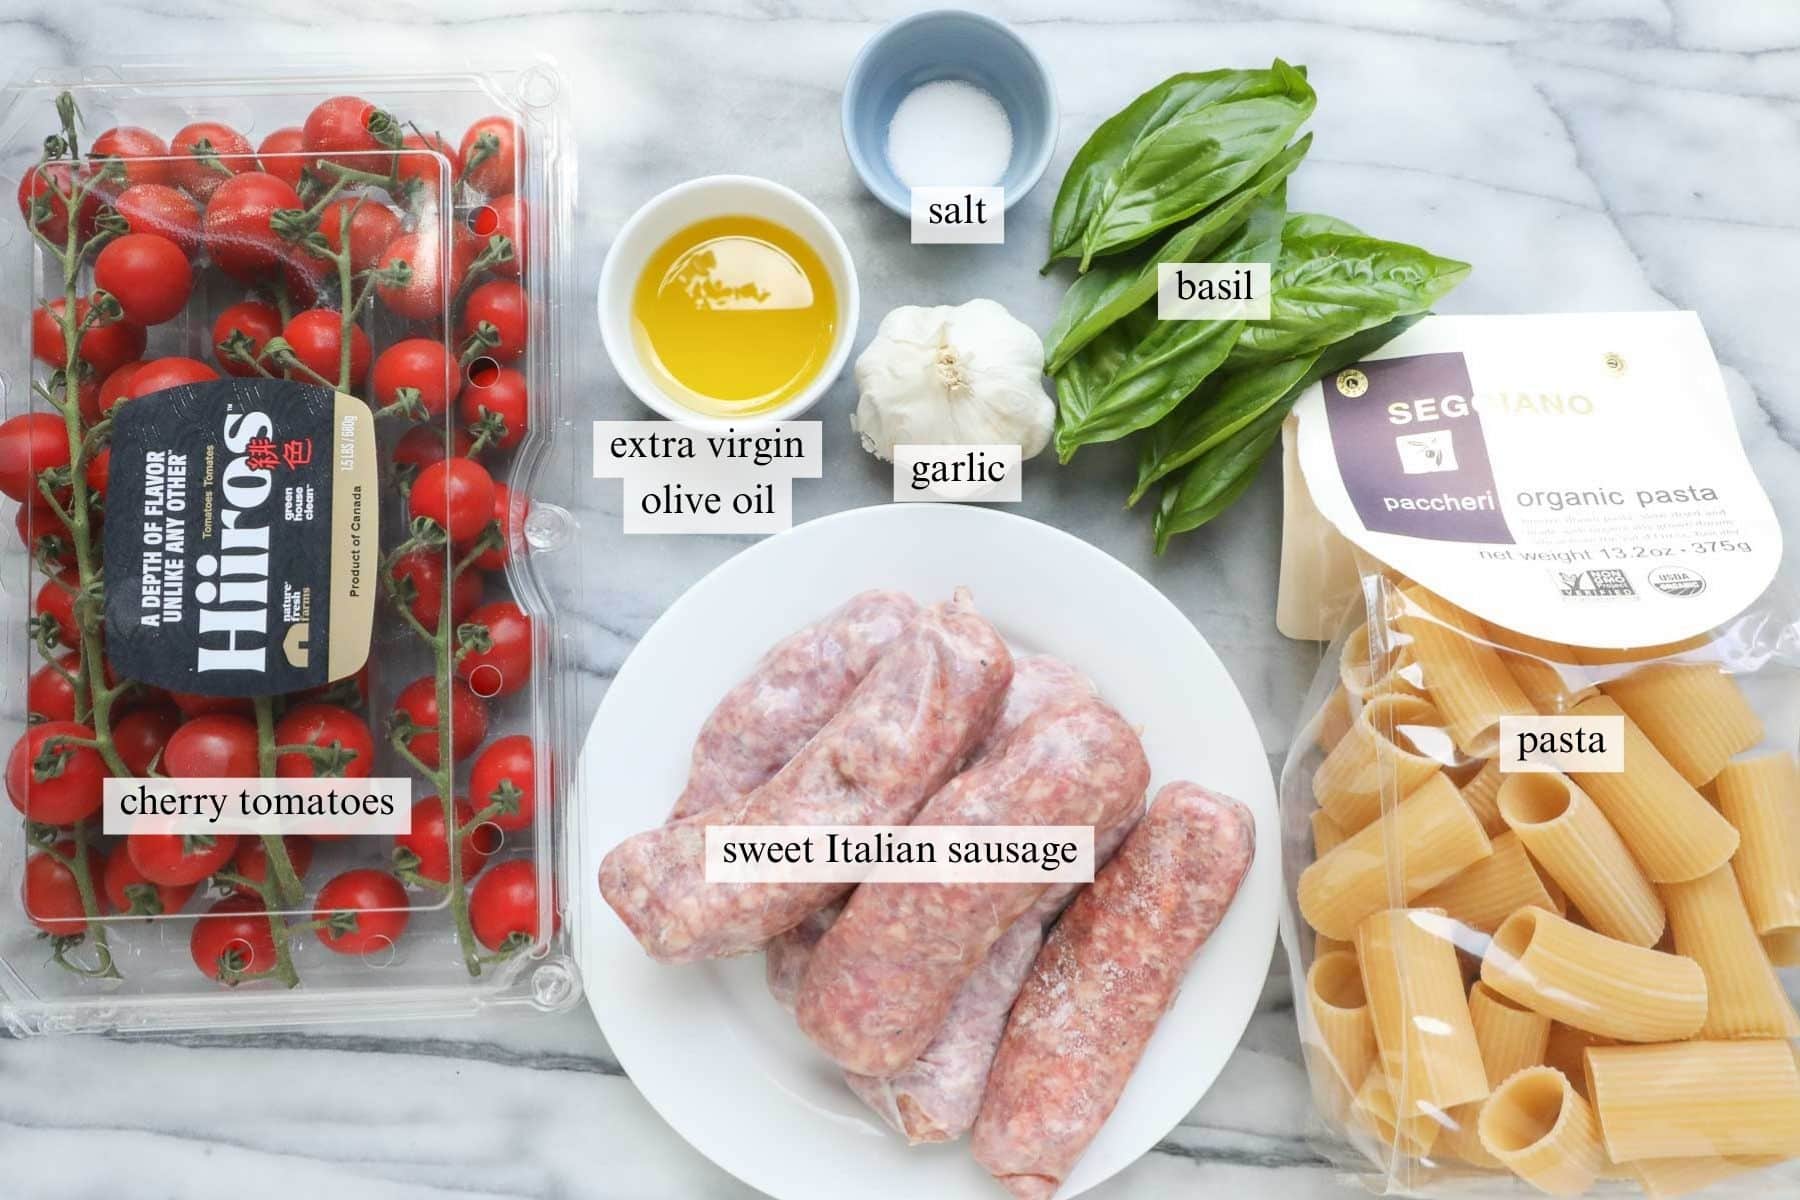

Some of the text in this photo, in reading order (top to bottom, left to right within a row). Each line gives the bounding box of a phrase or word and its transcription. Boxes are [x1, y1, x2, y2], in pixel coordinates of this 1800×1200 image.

[1388, 392, 1594, 425] SEGIANO
[202, 444, 215, 540] Tomatoes Tomates
[285, 487, 294, 520] green
[294, 486, 303, 521] house
[1384, 485, 1718, 512] paccheri organic pasta
[141, 451, 165, 627] A DEPTH OF FLAVOR
[165, 517, 186, 553] ANY
[195, 411, 273, 672] Hiiros
[350, 486, 361, 597] Product of Canada
[1479, 539, 1752, 564] net weight 13.2oz 375g
[163, 559, 184, 622] UNLIKE
[291, 591, 301, 622] fresh
[300, 587, 310, 622] farms
